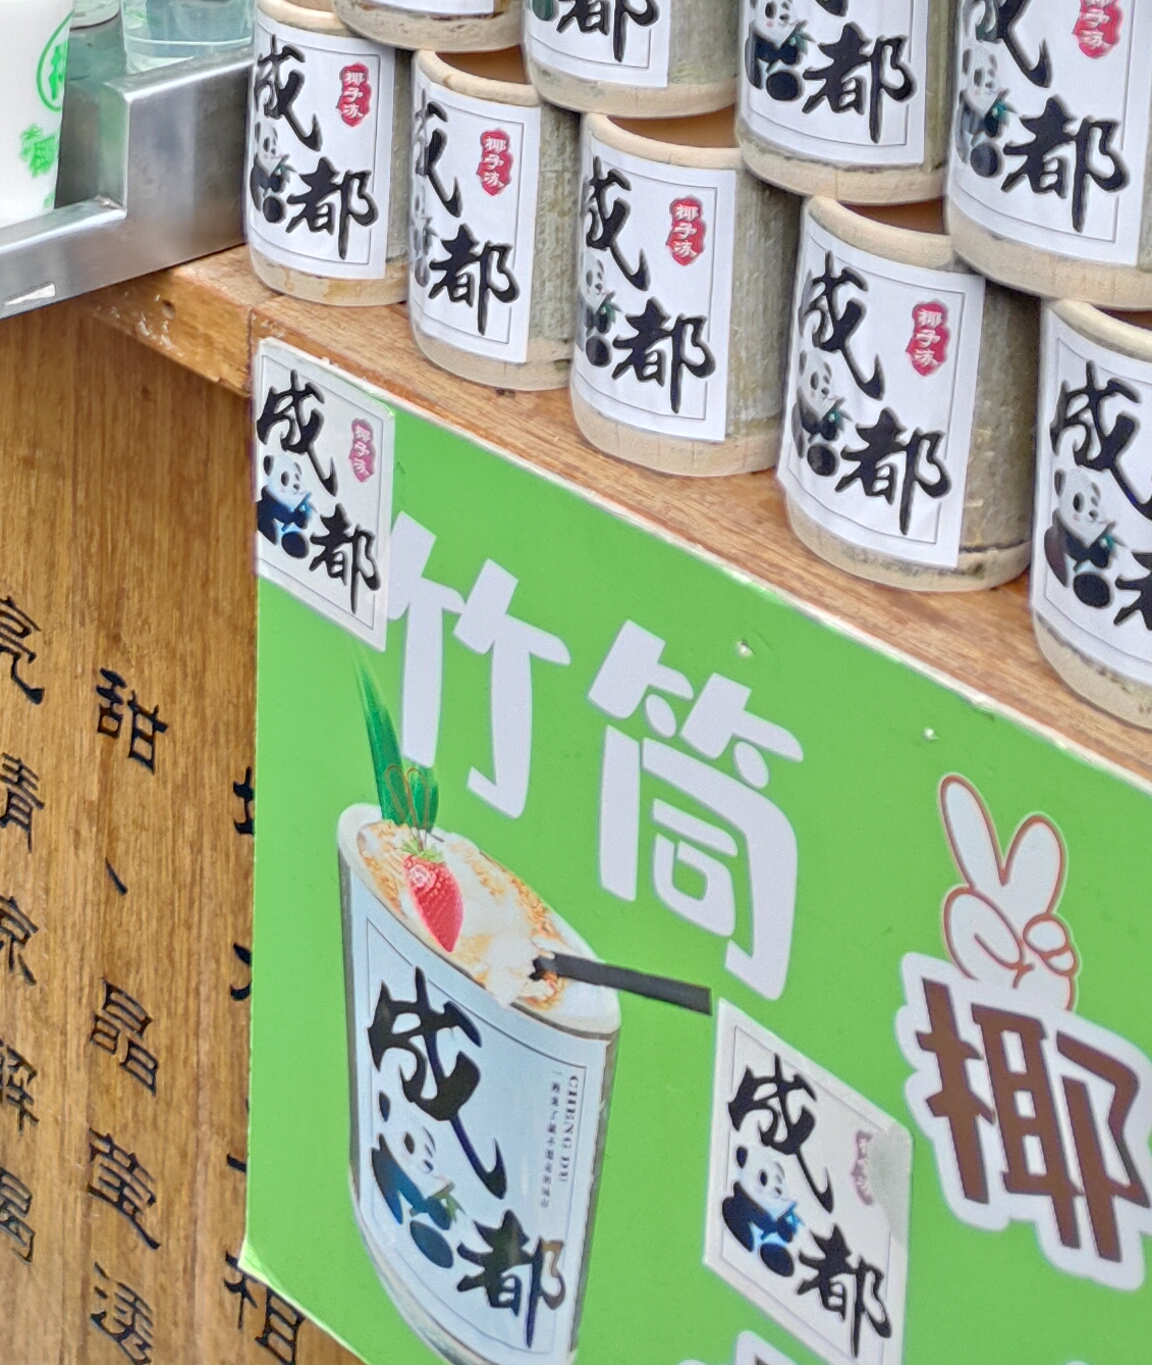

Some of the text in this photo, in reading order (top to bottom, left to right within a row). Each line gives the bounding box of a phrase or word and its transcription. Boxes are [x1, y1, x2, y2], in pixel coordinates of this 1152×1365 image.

[254, 34, 378, 261] 成都
[581, 155, 716, 413] 成都
[256, 369, 381, 615] 成都
[798, 252, 950, 535] 成都
[388, 510, 804, 1002] 竹筒
[367, 965, 565, 1349] 成都
[558, 1074, 580, 1183] CHENG DU
[728, 1053, 892, 1359] 成都
[915, 976, 1151, 1263] 椰
